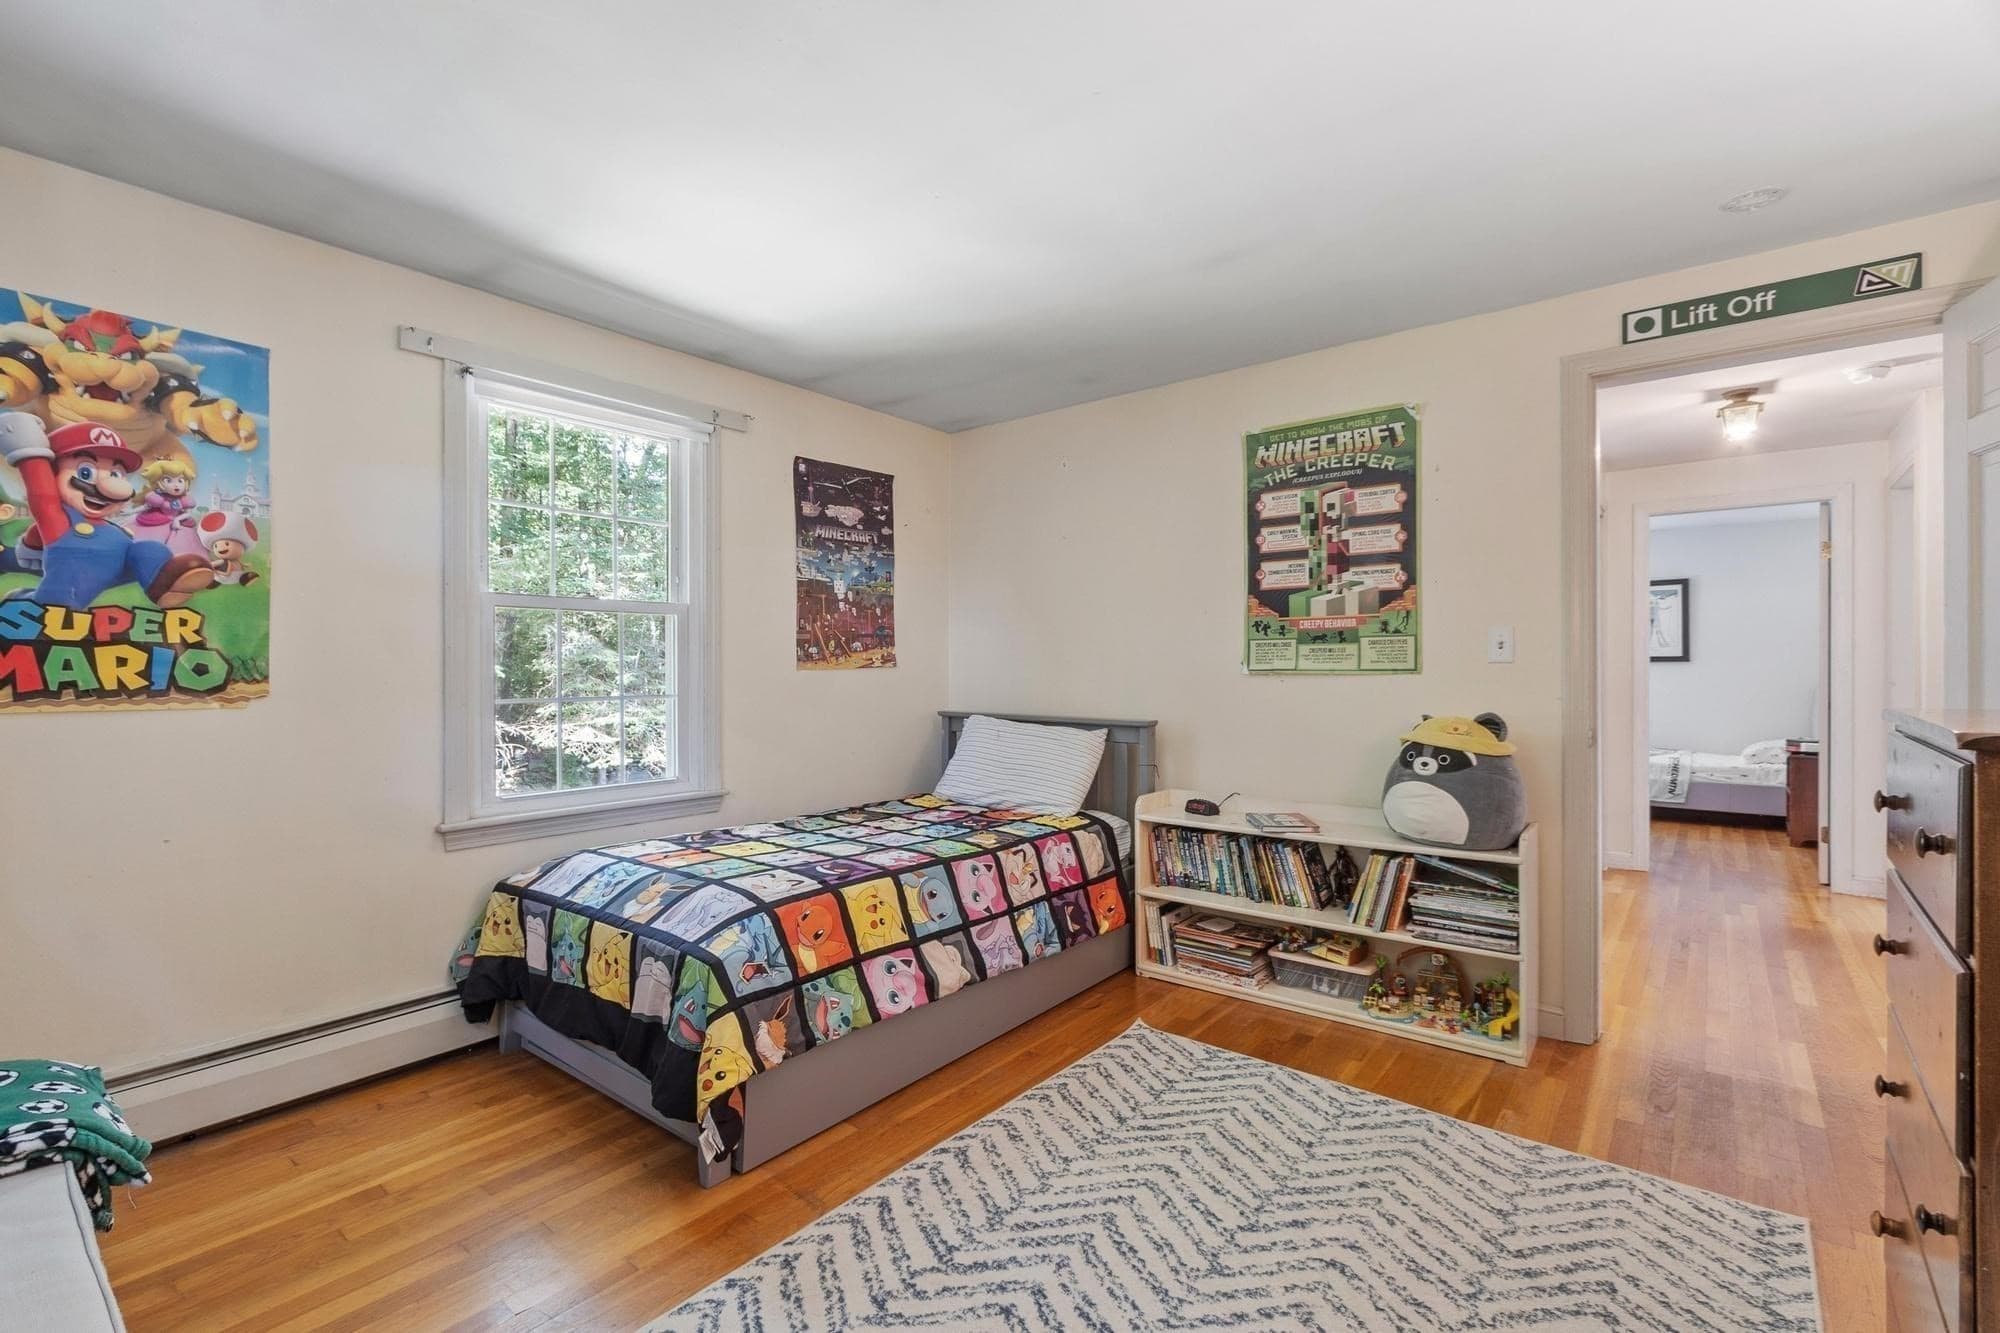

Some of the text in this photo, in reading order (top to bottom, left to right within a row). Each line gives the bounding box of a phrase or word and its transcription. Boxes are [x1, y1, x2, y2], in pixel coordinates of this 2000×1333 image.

[1670, 290, 1777, 330] Lift Off
[1255, 422, 1407, 470] MINECRAFT
[1288, 431, 1298, 440] TO
[1300, 426, 1326, 438] KNOW
[1328, 423, 1344, 432] THE
[1264, 453, 1396, 487] THE CREEPER
[815, 526, 879, 544] MINECRAFT
[0, 599, 204, 644] SUPER
[0, 643, 230, 694] MARIO
